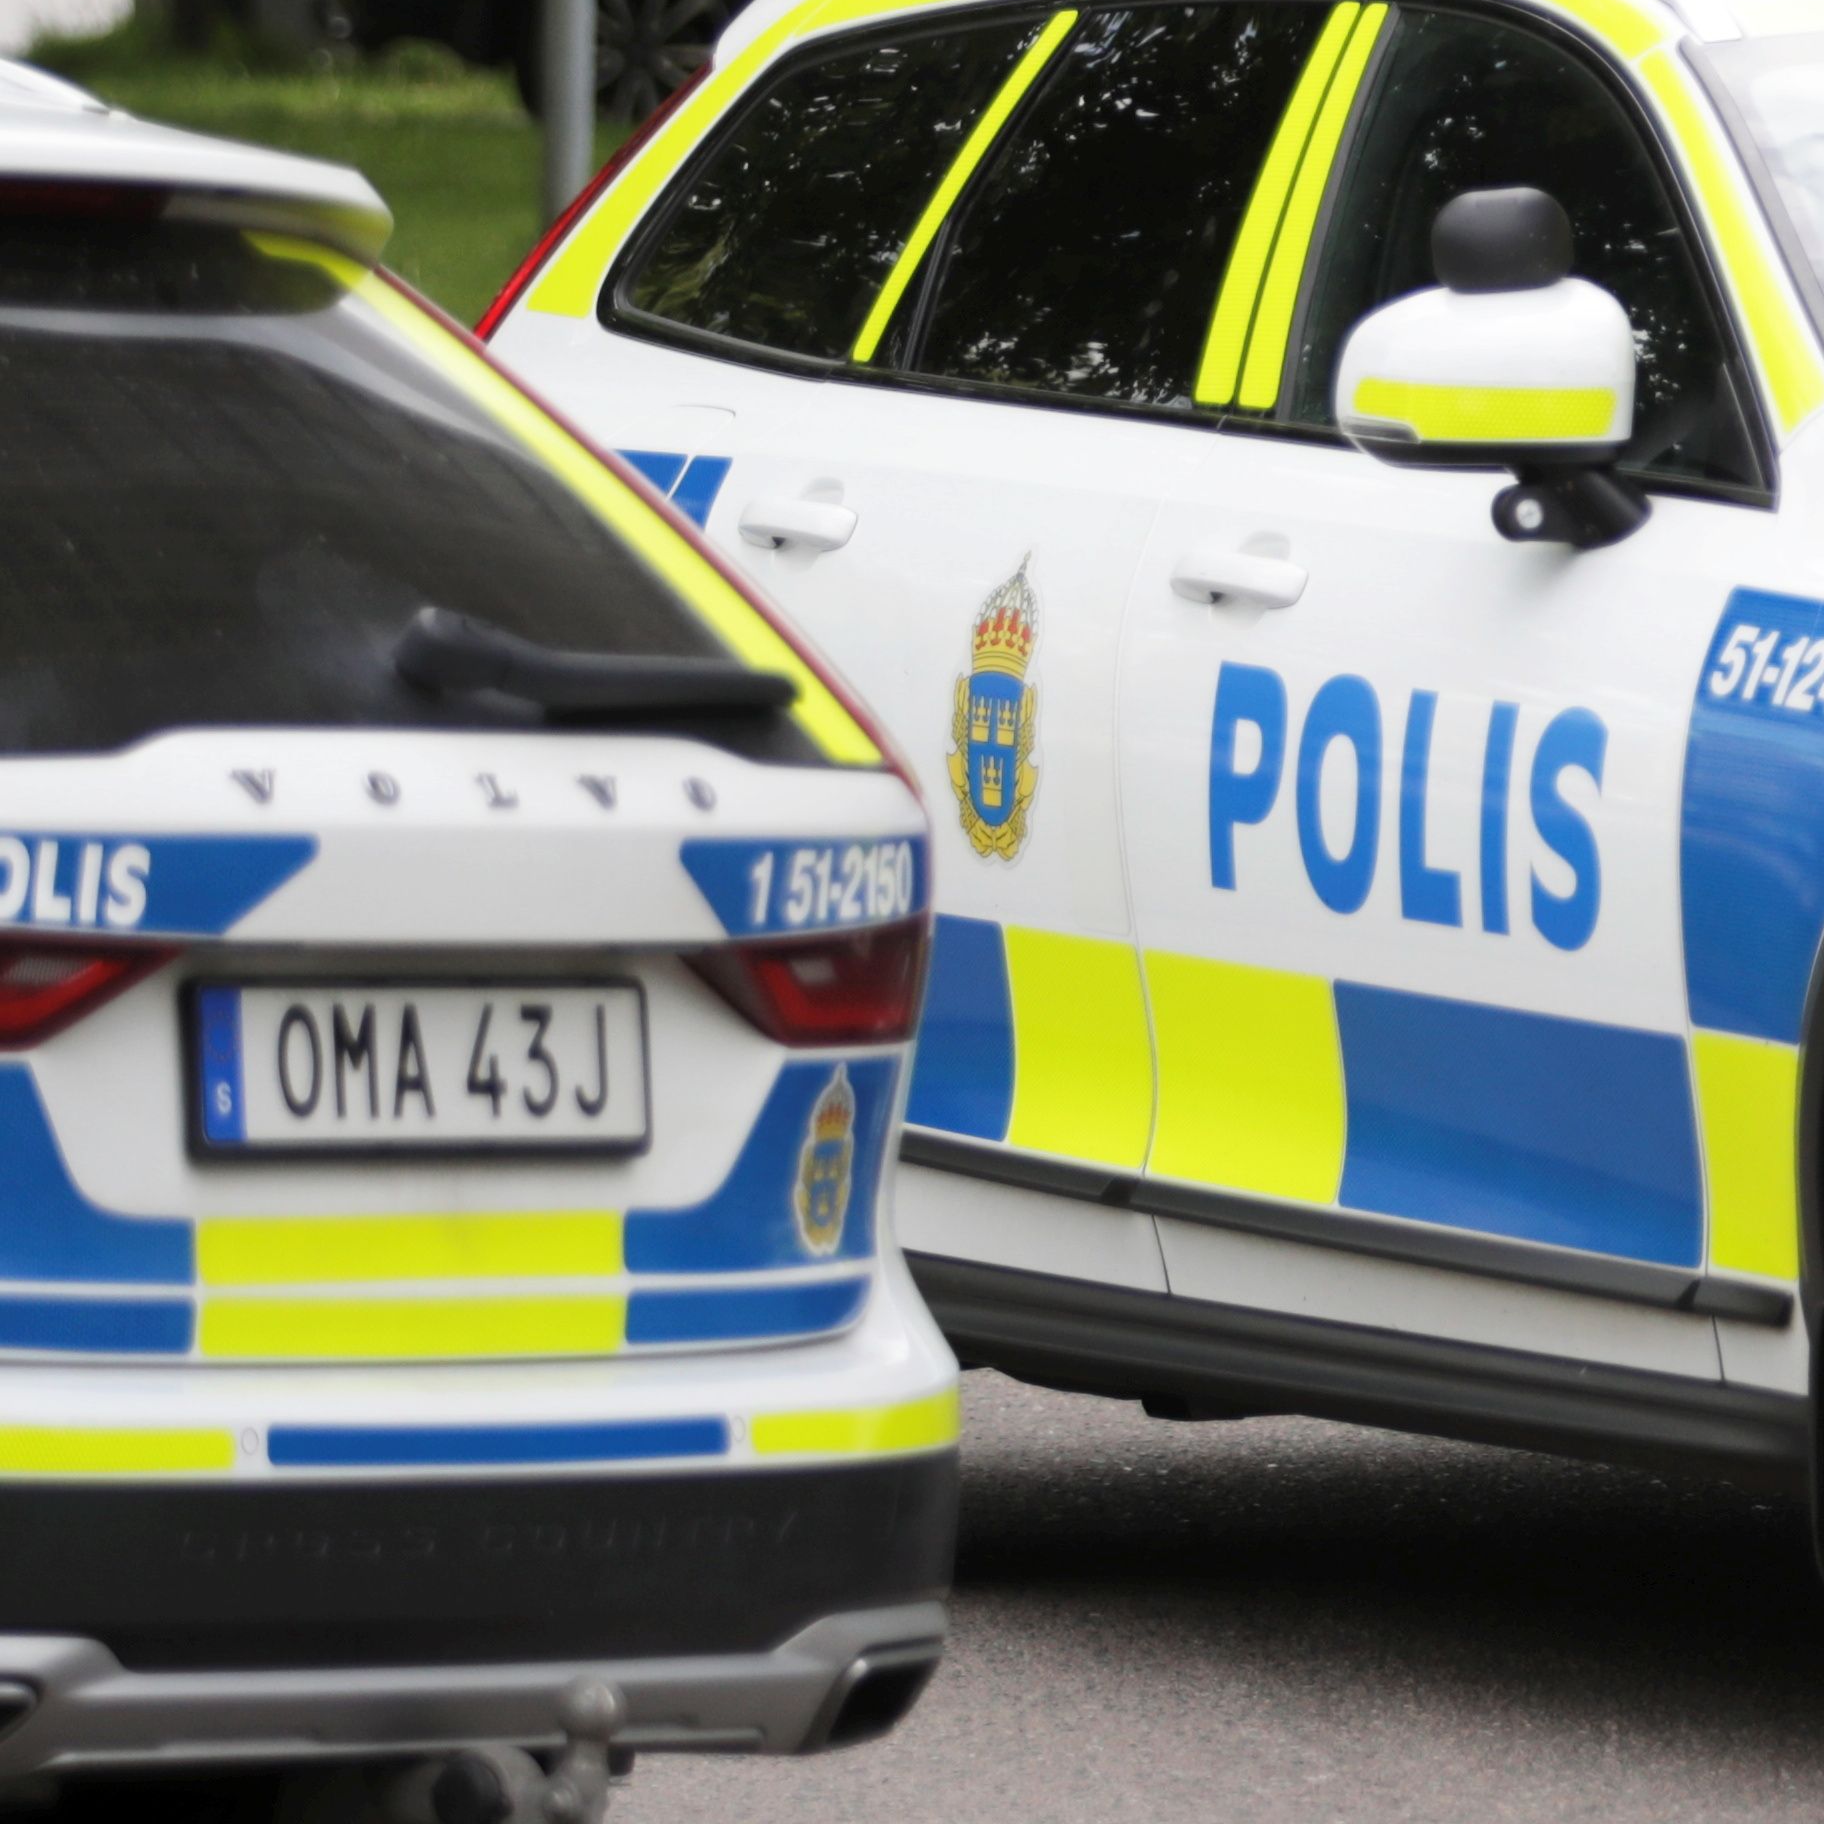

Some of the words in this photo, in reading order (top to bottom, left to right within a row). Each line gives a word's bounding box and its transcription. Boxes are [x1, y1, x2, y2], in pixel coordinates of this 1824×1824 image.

[228, 768, 718, 813] VOLVO
[1208, 662, 1606, 952] POLIS
[752, 850, 775, 925] 1
[785, 840, 914, 925] 51-2150
[276, 1000, 436, 1119] OMA
[466, 1000, 608, 1118] 43J
